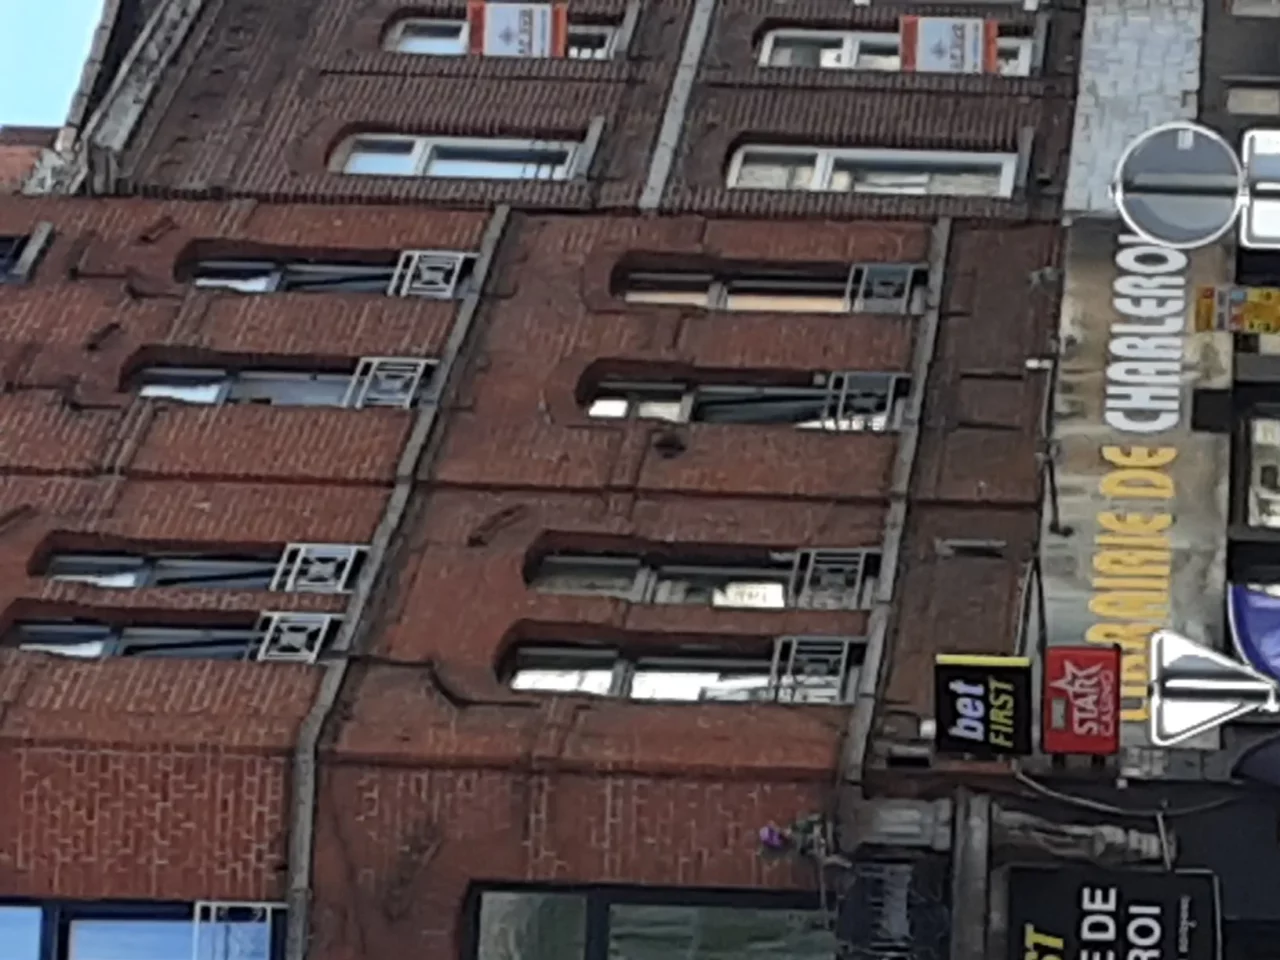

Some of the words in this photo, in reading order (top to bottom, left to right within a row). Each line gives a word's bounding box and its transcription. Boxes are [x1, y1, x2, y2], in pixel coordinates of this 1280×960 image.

[1098, 445, 1178, 498] DE
[948, 678, 986, 741] bet
[987, 675, 1015, 748] FIRST
[1071, 675, 1102, 736] STAR
[1080, 887, 1118, 942] DE
